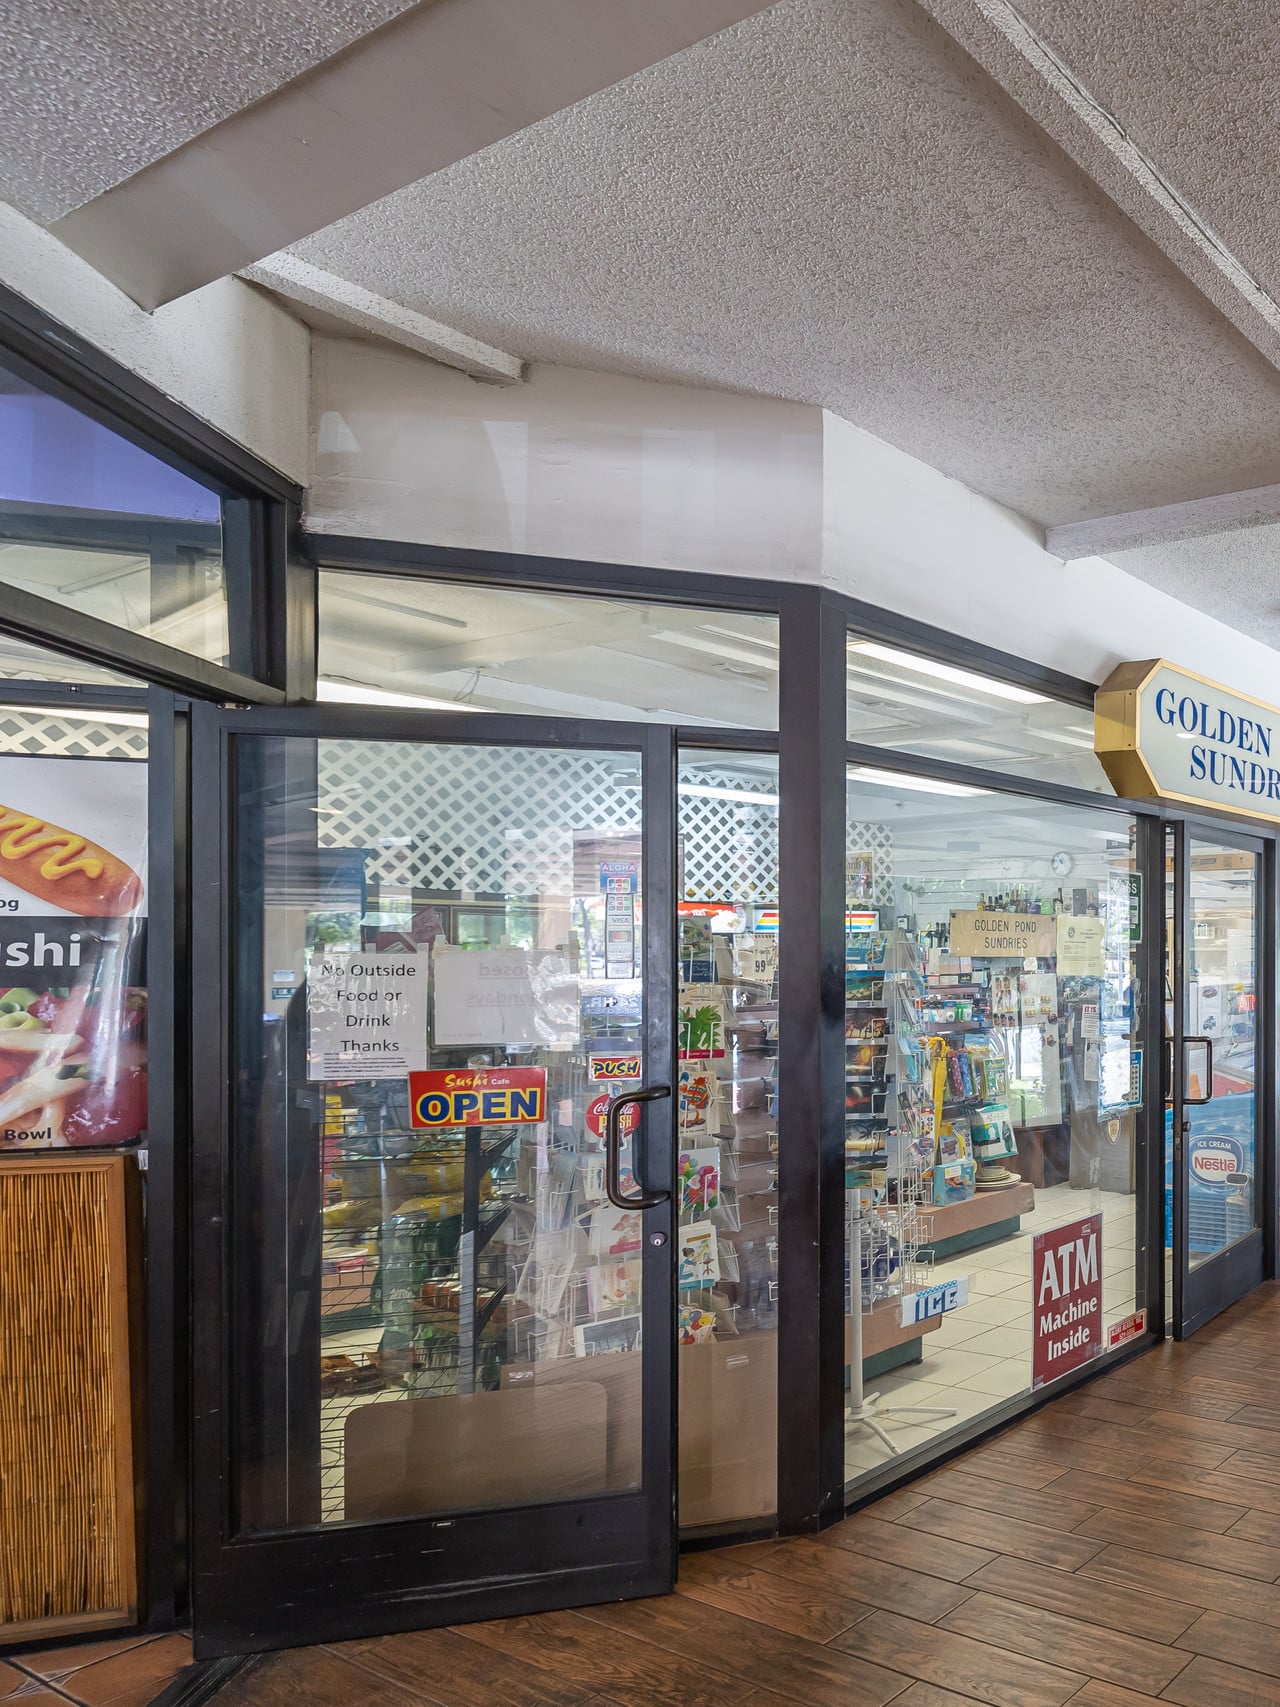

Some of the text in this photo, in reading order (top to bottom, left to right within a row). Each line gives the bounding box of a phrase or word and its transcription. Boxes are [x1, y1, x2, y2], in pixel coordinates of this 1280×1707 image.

[1156, 688, 1272, 757] GOLDEN
[601, 862, 636, 871] ALOHA
[974, 919, 1037, 933] GOLDEN POND
[0, 932, 81, 967] shi
[984, 937, 1028, 949] SUNDRIES
[321, 964, 416, 977] No Outside
[337, 990, 402, 1002] Food or
[346, 1014, 391, 1027] Drink
[340, 1039, 400, 1052] Thanks
[593, 1061, 638, 1075] PUSH
[444, 1073, 488, 1088] Sushi
[416, 1088, 540, 1124] OPEN
[598, 1115, 632, 1132] PSH
[4, 1127, 52, 1140] Bowl
[1208, 1141, 1232, 1150] CREAM
[1038, 1232, 1099, 1307] ATM
[915, 1286, 958, 1323] ICE
[1039, 1296, 1098, 1338] Machine
[1047, 1325, 1090, 1362] Inside
